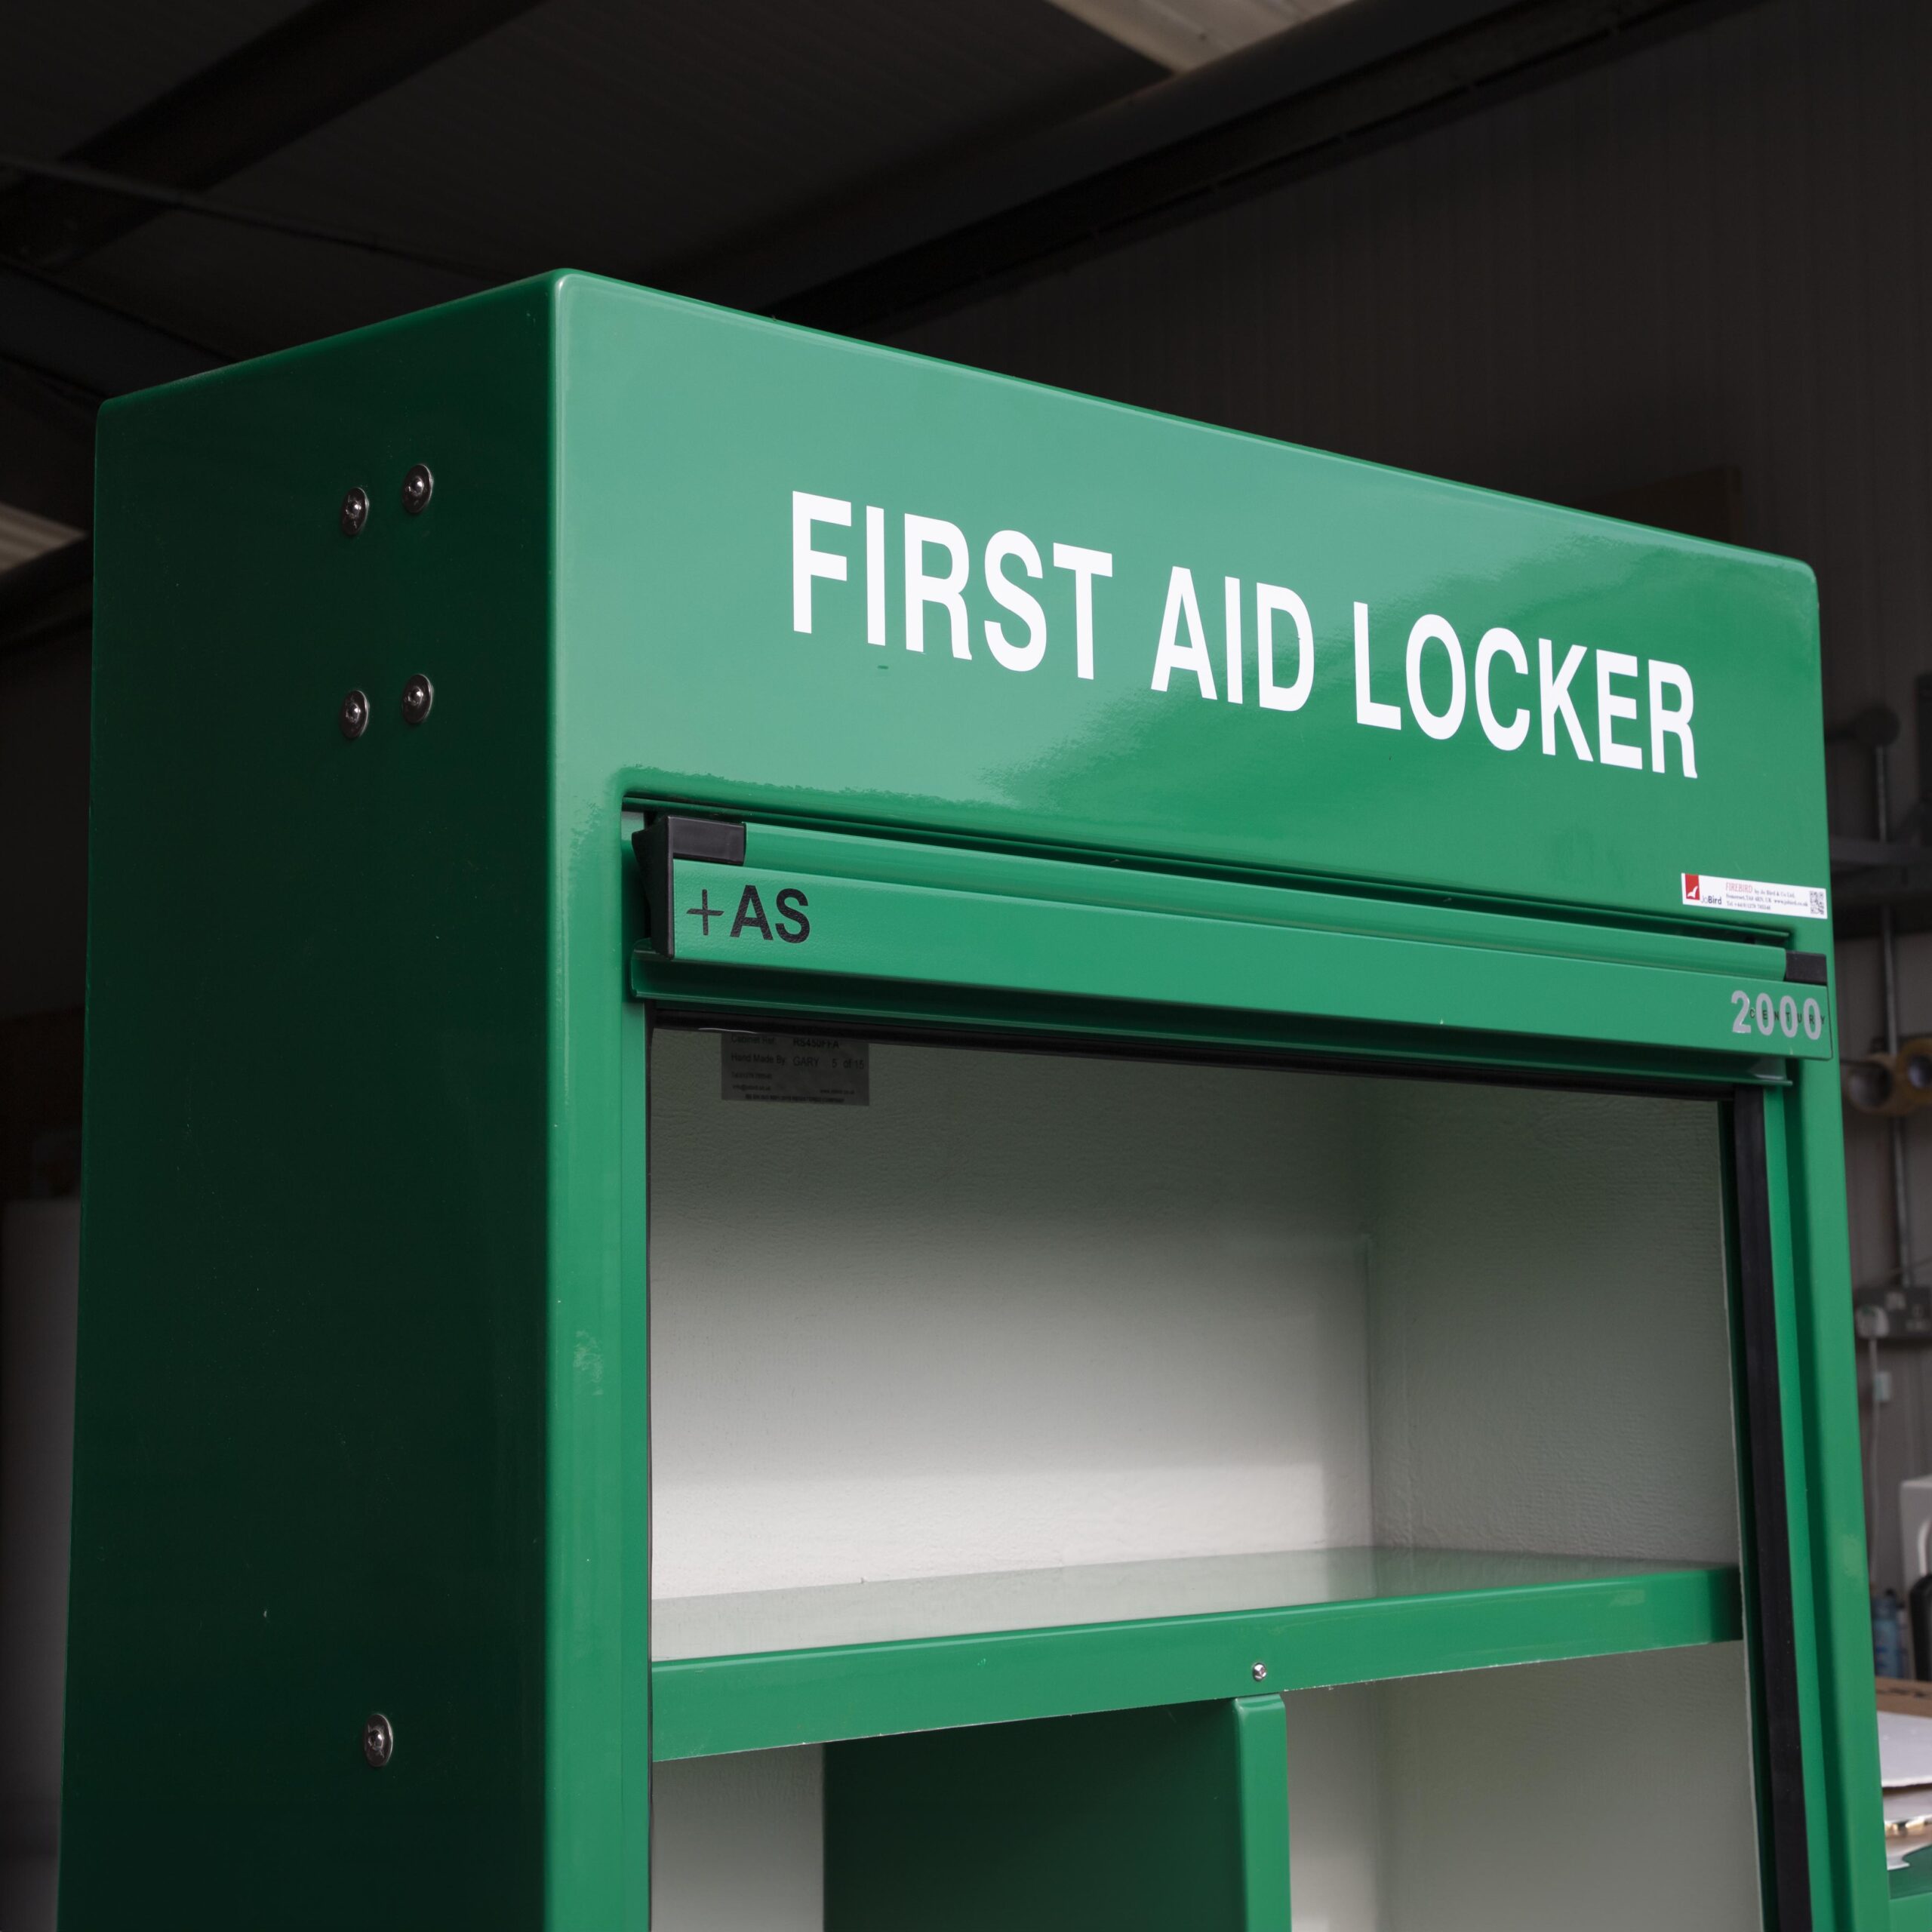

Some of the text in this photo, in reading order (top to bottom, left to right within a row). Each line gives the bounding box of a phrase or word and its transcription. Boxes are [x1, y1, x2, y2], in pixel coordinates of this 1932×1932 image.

[792, 491, 1698, 780] FIRST AID LOCKER
[1725, 882, 1753, 894] FIREBIRD
[1701, 895, 1722, 906] JoBird
[1730, 989, 1822, 1040] 2000
[1749, 1008, 1826, 1025] CENTURY
[731, 1052, 752, 1063] Hand
[753, 1054, 774, 1063] Made
[776, 1055, 786, 1066] By
[792, 1057, 820, 1066] GARY
